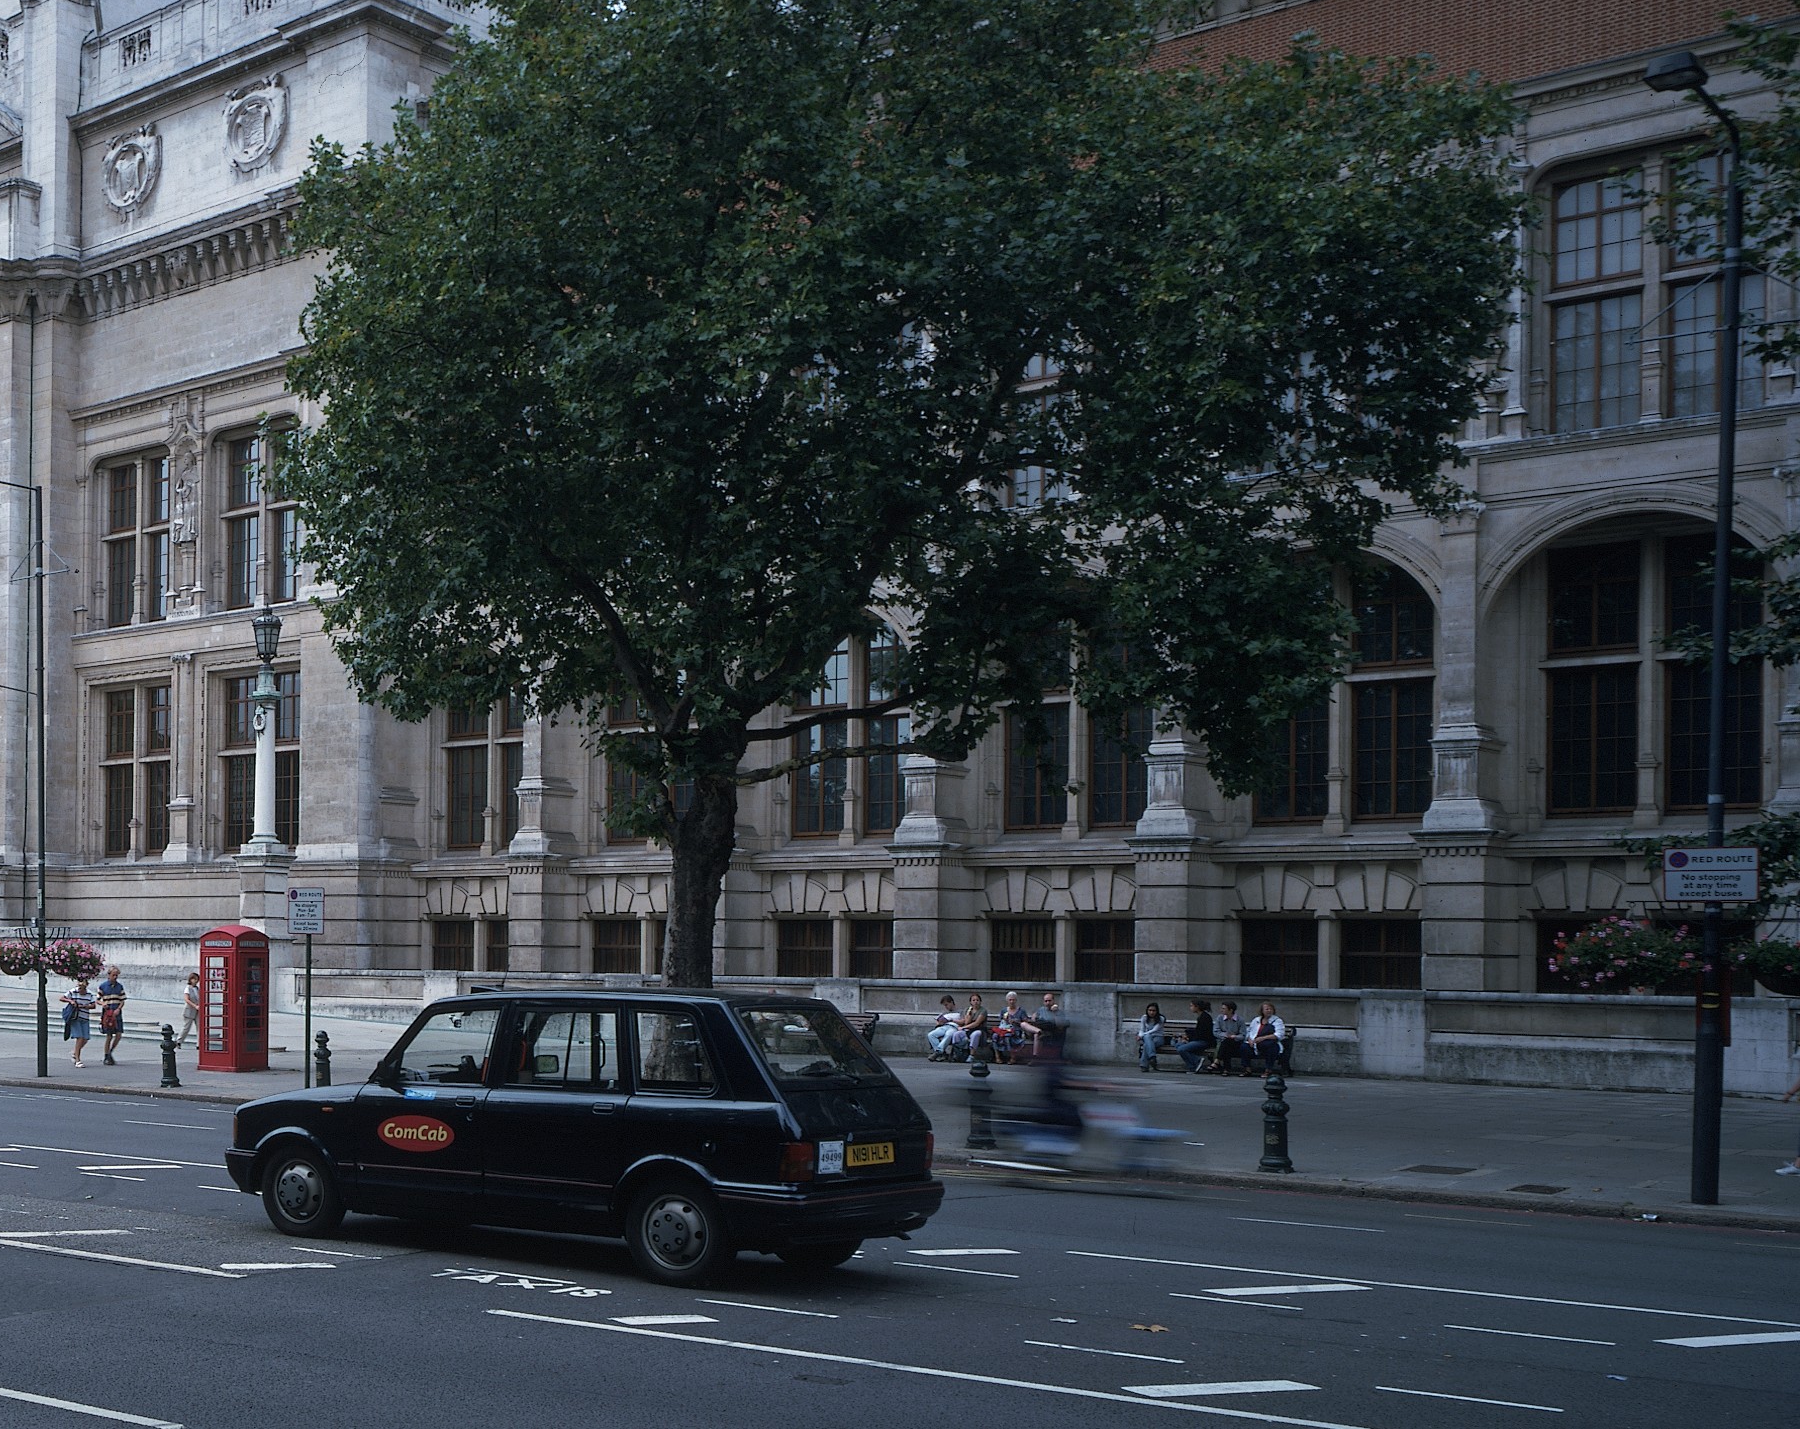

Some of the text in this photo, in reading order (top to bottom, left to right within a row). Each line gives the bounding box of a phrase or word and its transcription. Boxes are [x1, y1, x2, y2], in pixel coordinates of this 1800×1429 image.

[1717, 855, 1753, 863] ROUTE
[1698, 874, 1741, 882] stopping
[383, 1122, 448, 1142] ComCab
[821, 1152, 842, 1162] 49499
[852, 1145, 890, 1163] N191 HLR
[430, 1268, 612, 1297] TAXIS
